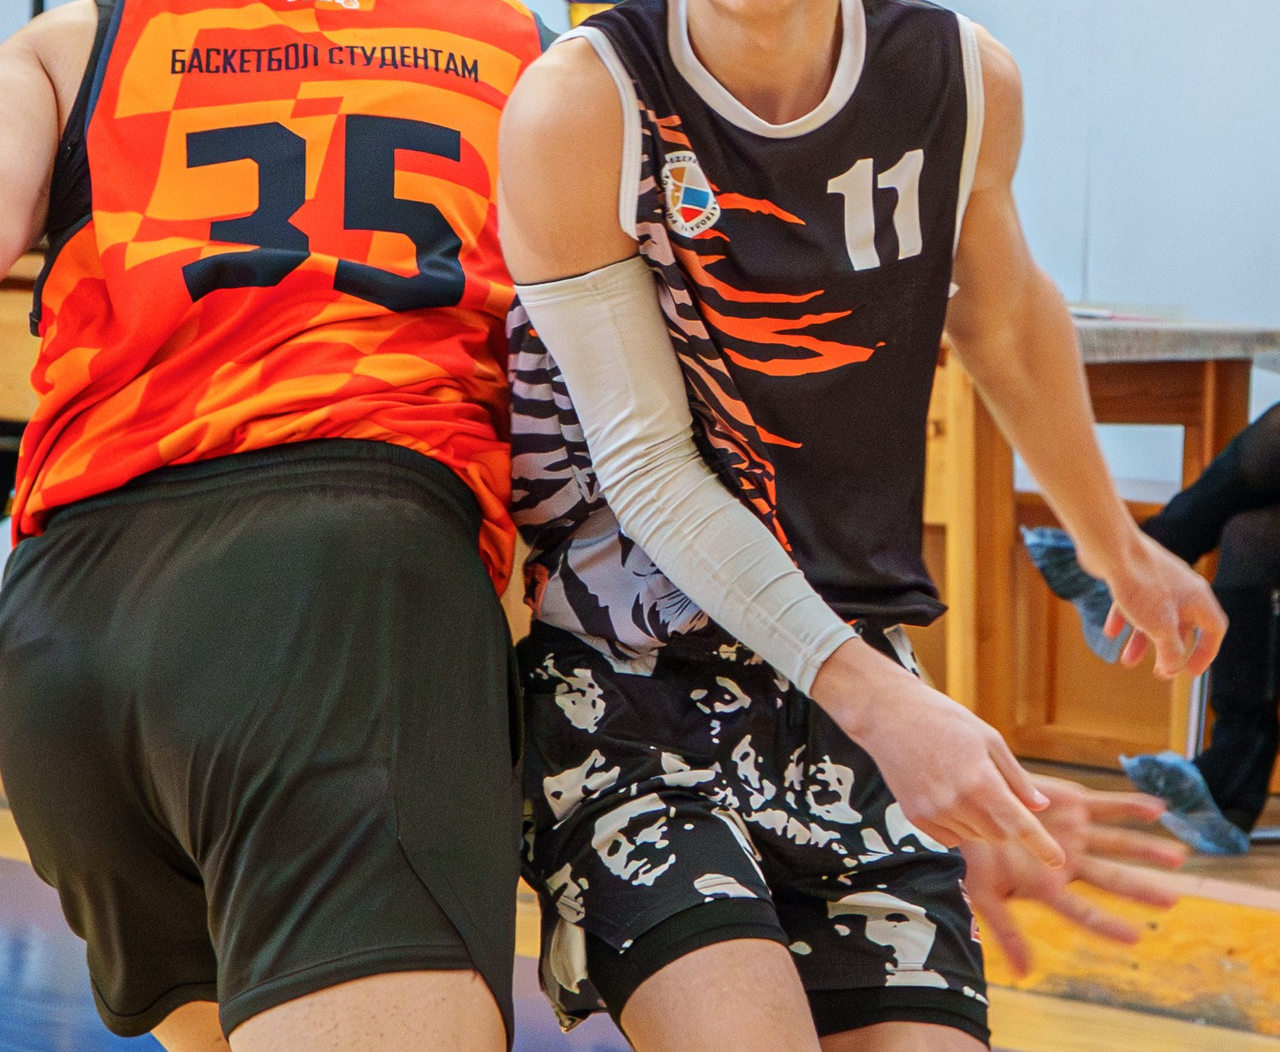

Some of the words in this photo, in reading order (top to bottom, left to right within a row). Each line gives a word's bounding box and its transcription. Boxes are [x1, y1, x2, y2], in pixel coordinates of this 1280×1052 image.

[169, 42, 320, 75] БАСКЕТБОЛ
[328, 44, 480, 84] СТУДЕНТАМ
[181, 113, 467, 313] 35
[826, 148, 925, 272] 11
